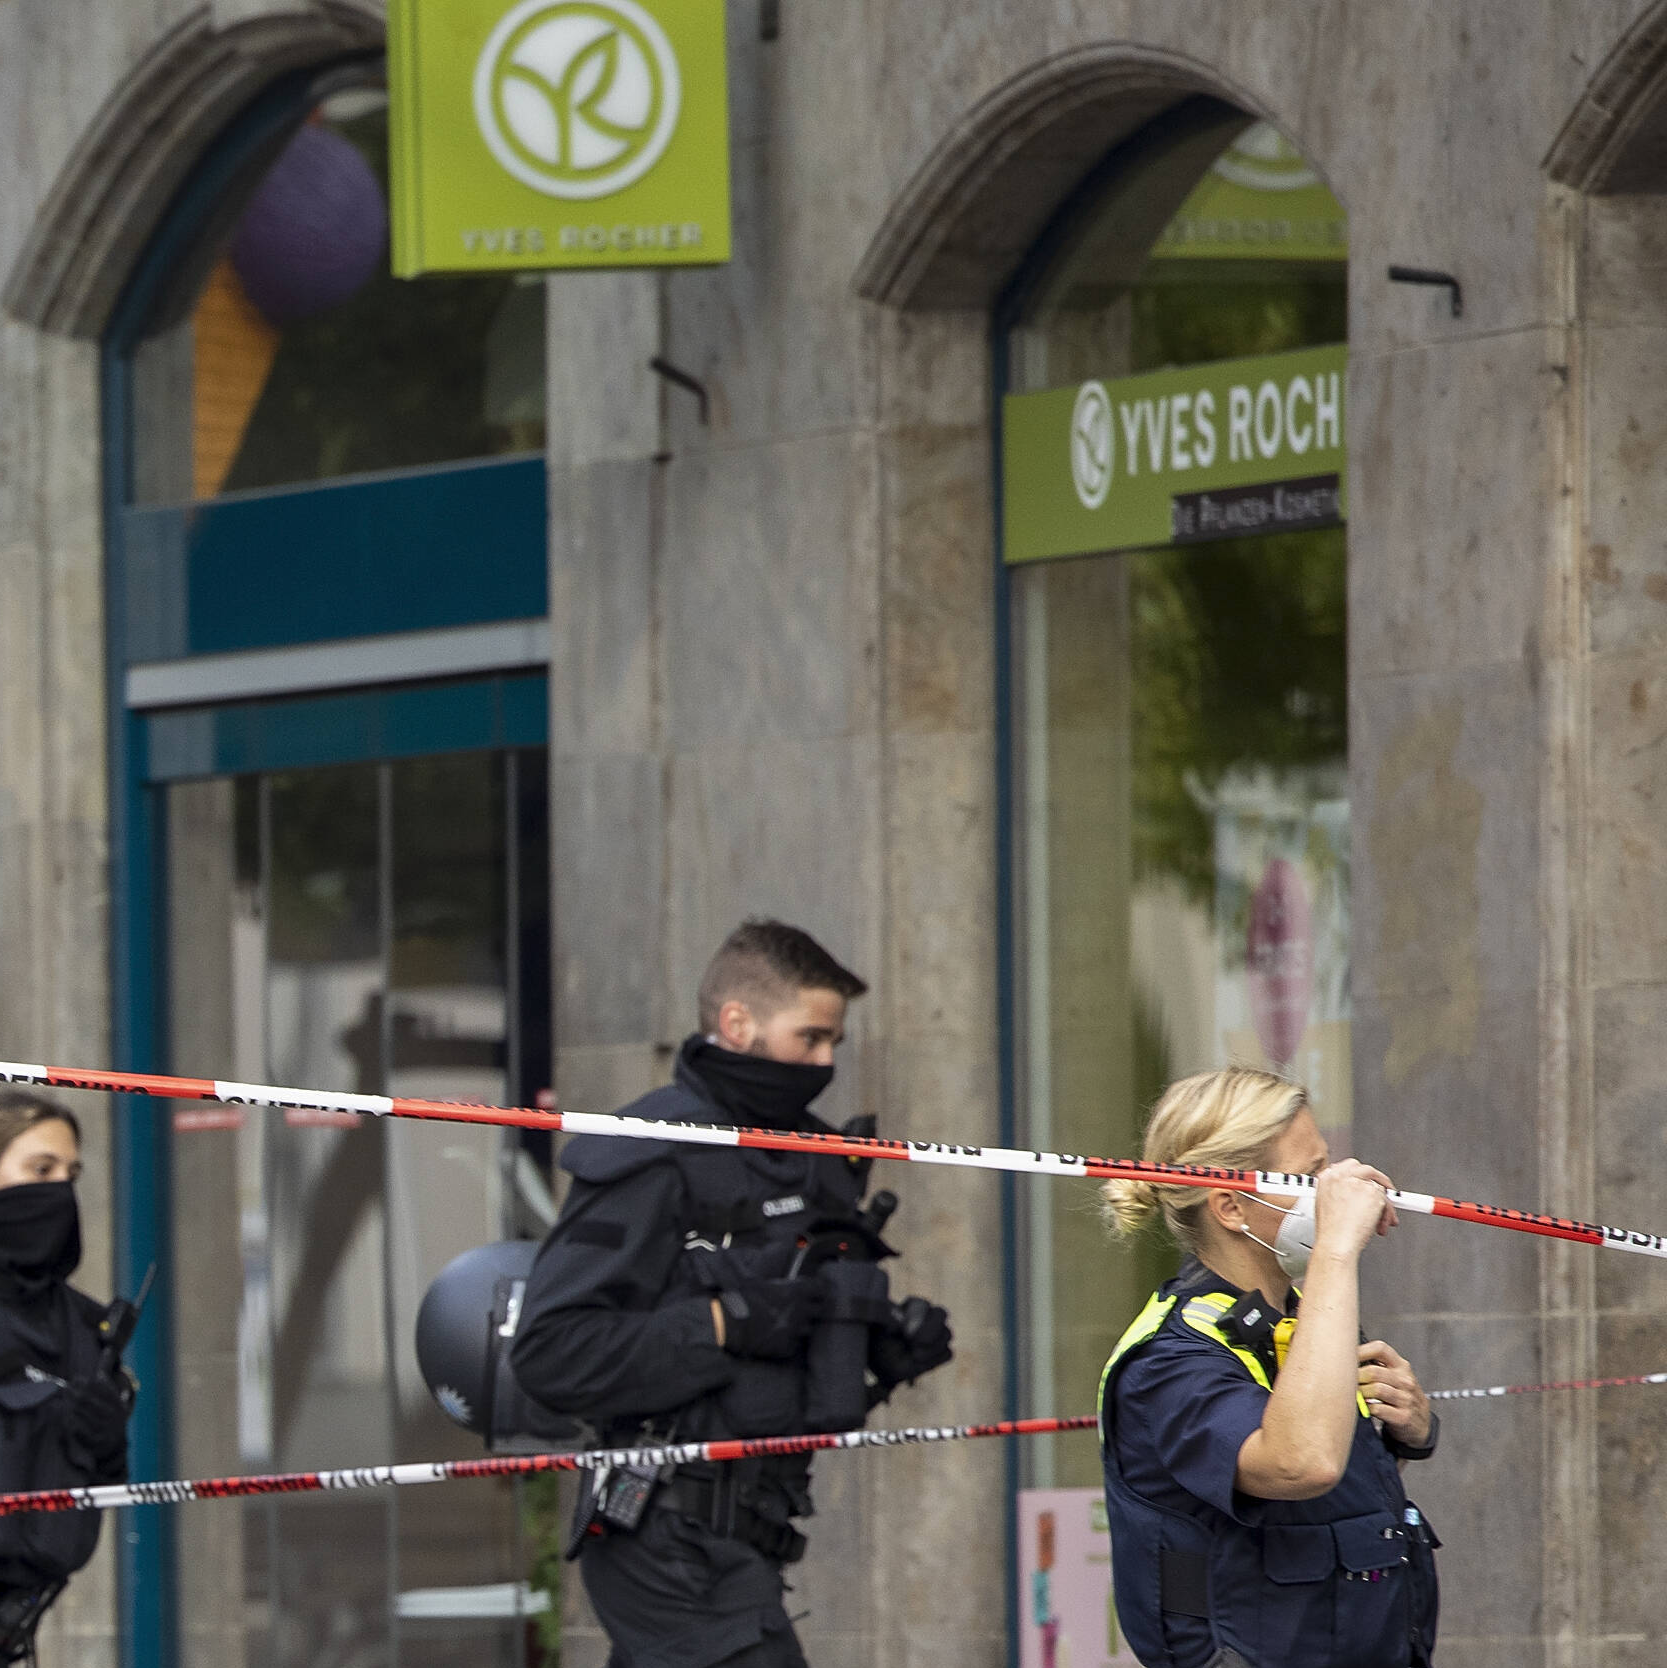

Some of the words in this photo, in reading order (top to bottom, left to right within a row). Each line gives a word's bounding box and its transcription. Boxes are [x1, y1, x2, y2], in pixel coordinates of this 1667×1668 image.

[461, 228, 545, 255] YVES
[560, 223, 703, 252] ROCHER
[1120, 389, 1216, 476] YVES
[1229, 371, 1344, 462] ROCH
